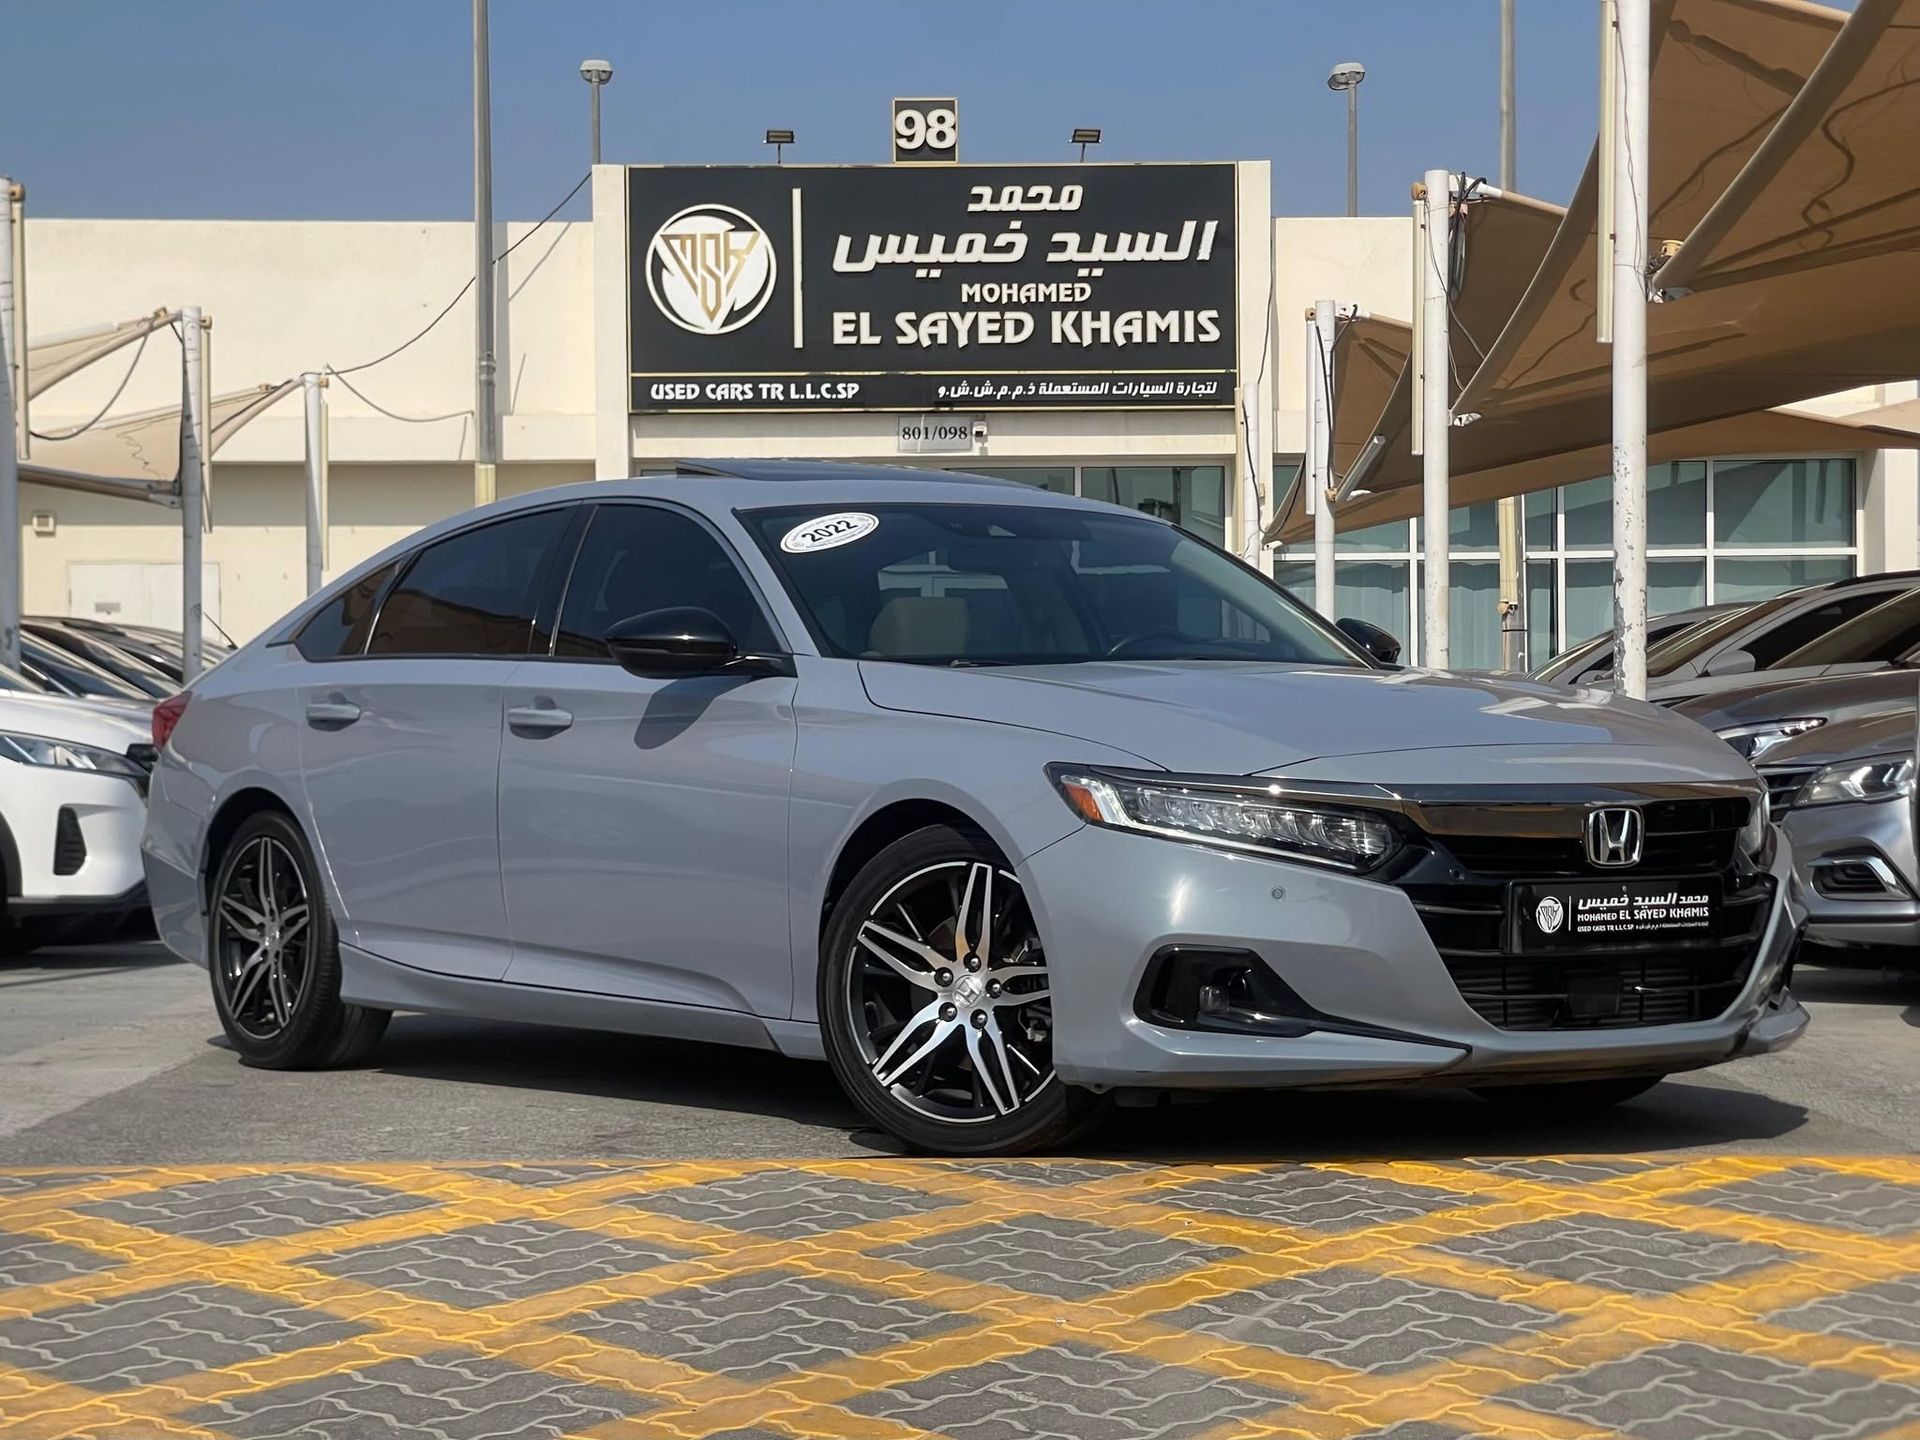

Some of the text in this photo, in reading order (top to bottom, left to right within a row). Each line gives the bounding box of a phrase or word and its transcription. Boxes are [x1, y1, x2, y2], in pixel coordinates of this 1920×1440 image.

[895, 109, 957, 149] 98
[967, 184, 1083, 212] محمد
[832, 220, 1219, 278] السيد خميس
[961, 282, 1092, 305] MOHAMED
[833, 309, 1221, 348] EL SAYED KHAMIS
[650, 383, 700, 400] USED
[705, 383, 754, 401] CARS
[758, 383, 785, 401] TR
[1038, 381, 1109, 396] المستعملة
[1112, 382, 1173, 398] السيارات
[1176, 381, 1218, 398] لتجارة
[902, 425, 968, 441] 801/098
[802, 520, 858, 543] 2022
[1577, 892, 1709, 910] محمد السيد خميس
[1577, 907, 1709, 922] MOHAMED EL SAYED KHAMIS
